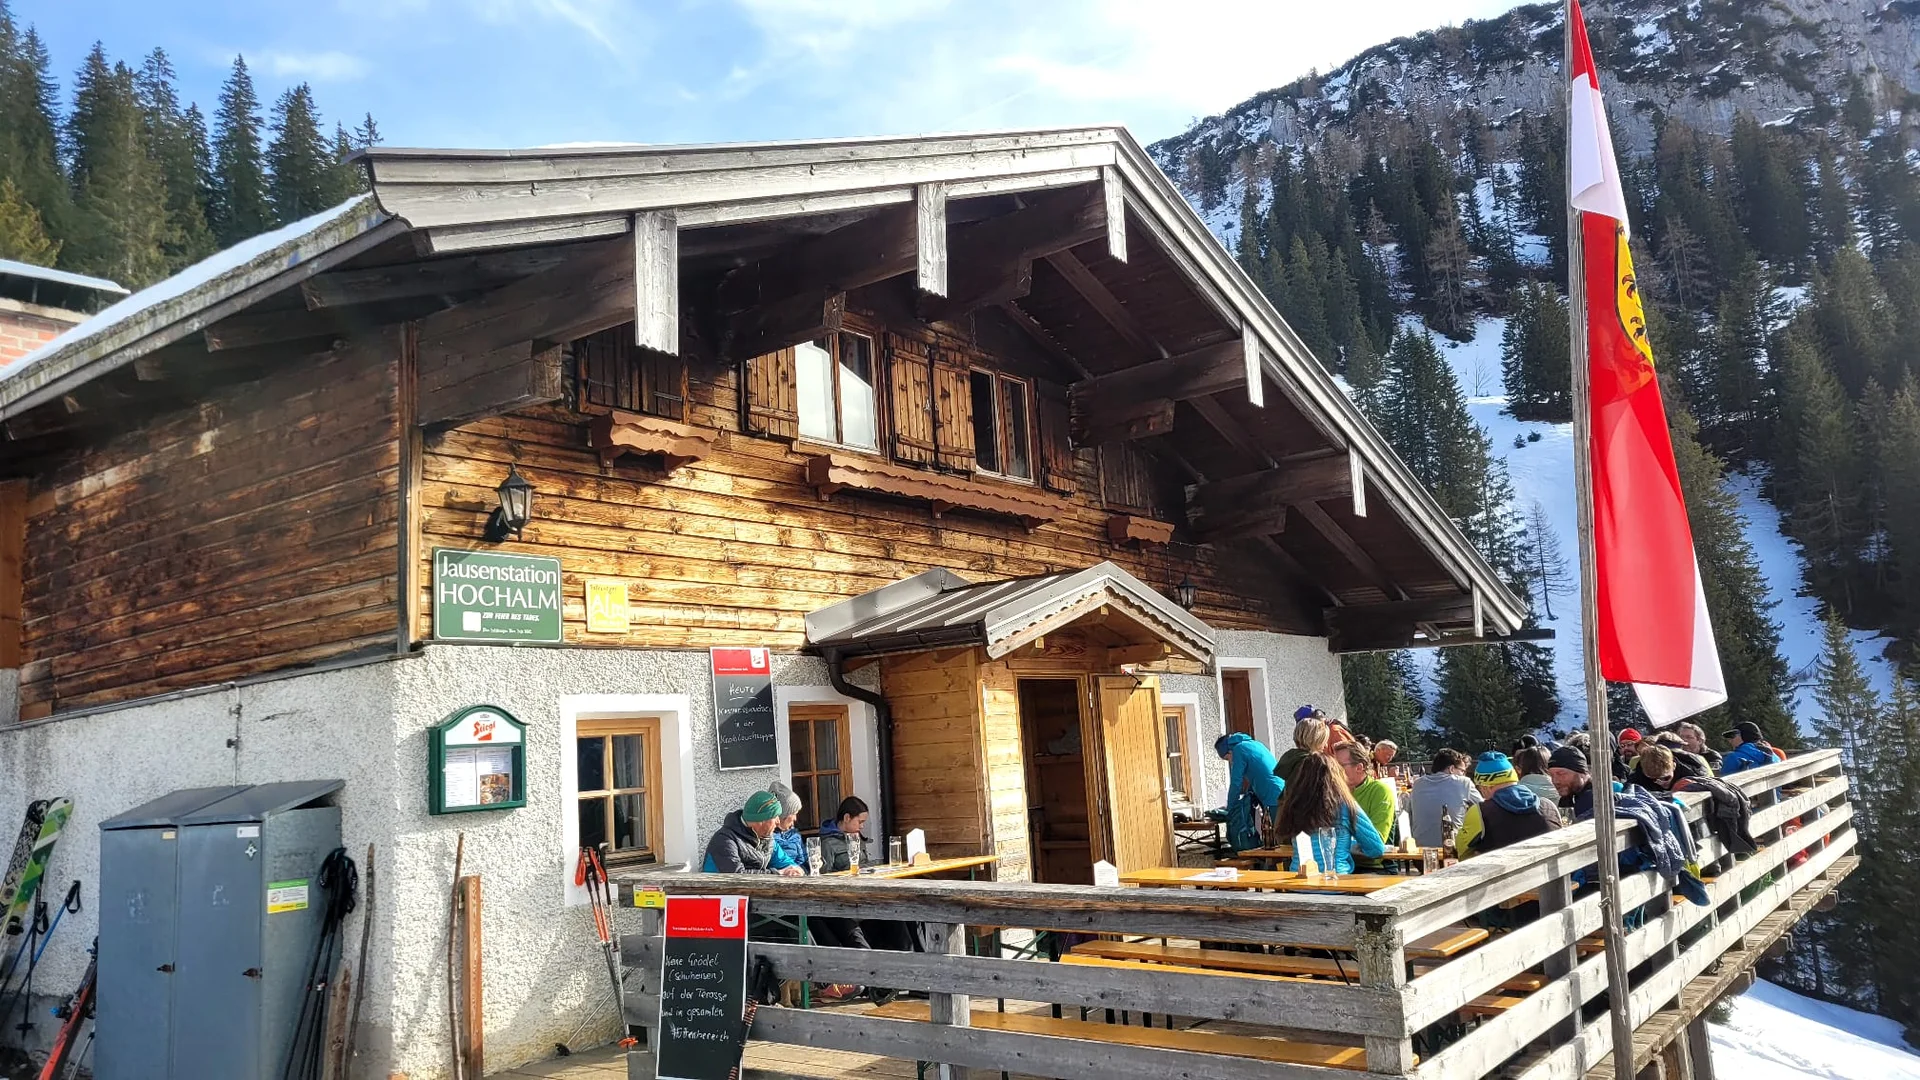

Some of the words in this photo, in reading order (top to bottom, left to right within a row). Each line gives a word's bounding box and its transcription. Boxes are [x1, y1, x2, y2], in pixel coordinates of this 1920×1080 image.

[441, 556, 557, 585] Jausenstation
[440, 582, 558, 610] HOCHALM
[473, 720, 496, 737] Stiegl
[662, 987, 675, 1000] auf
[680, 989, 694, 1000] der
